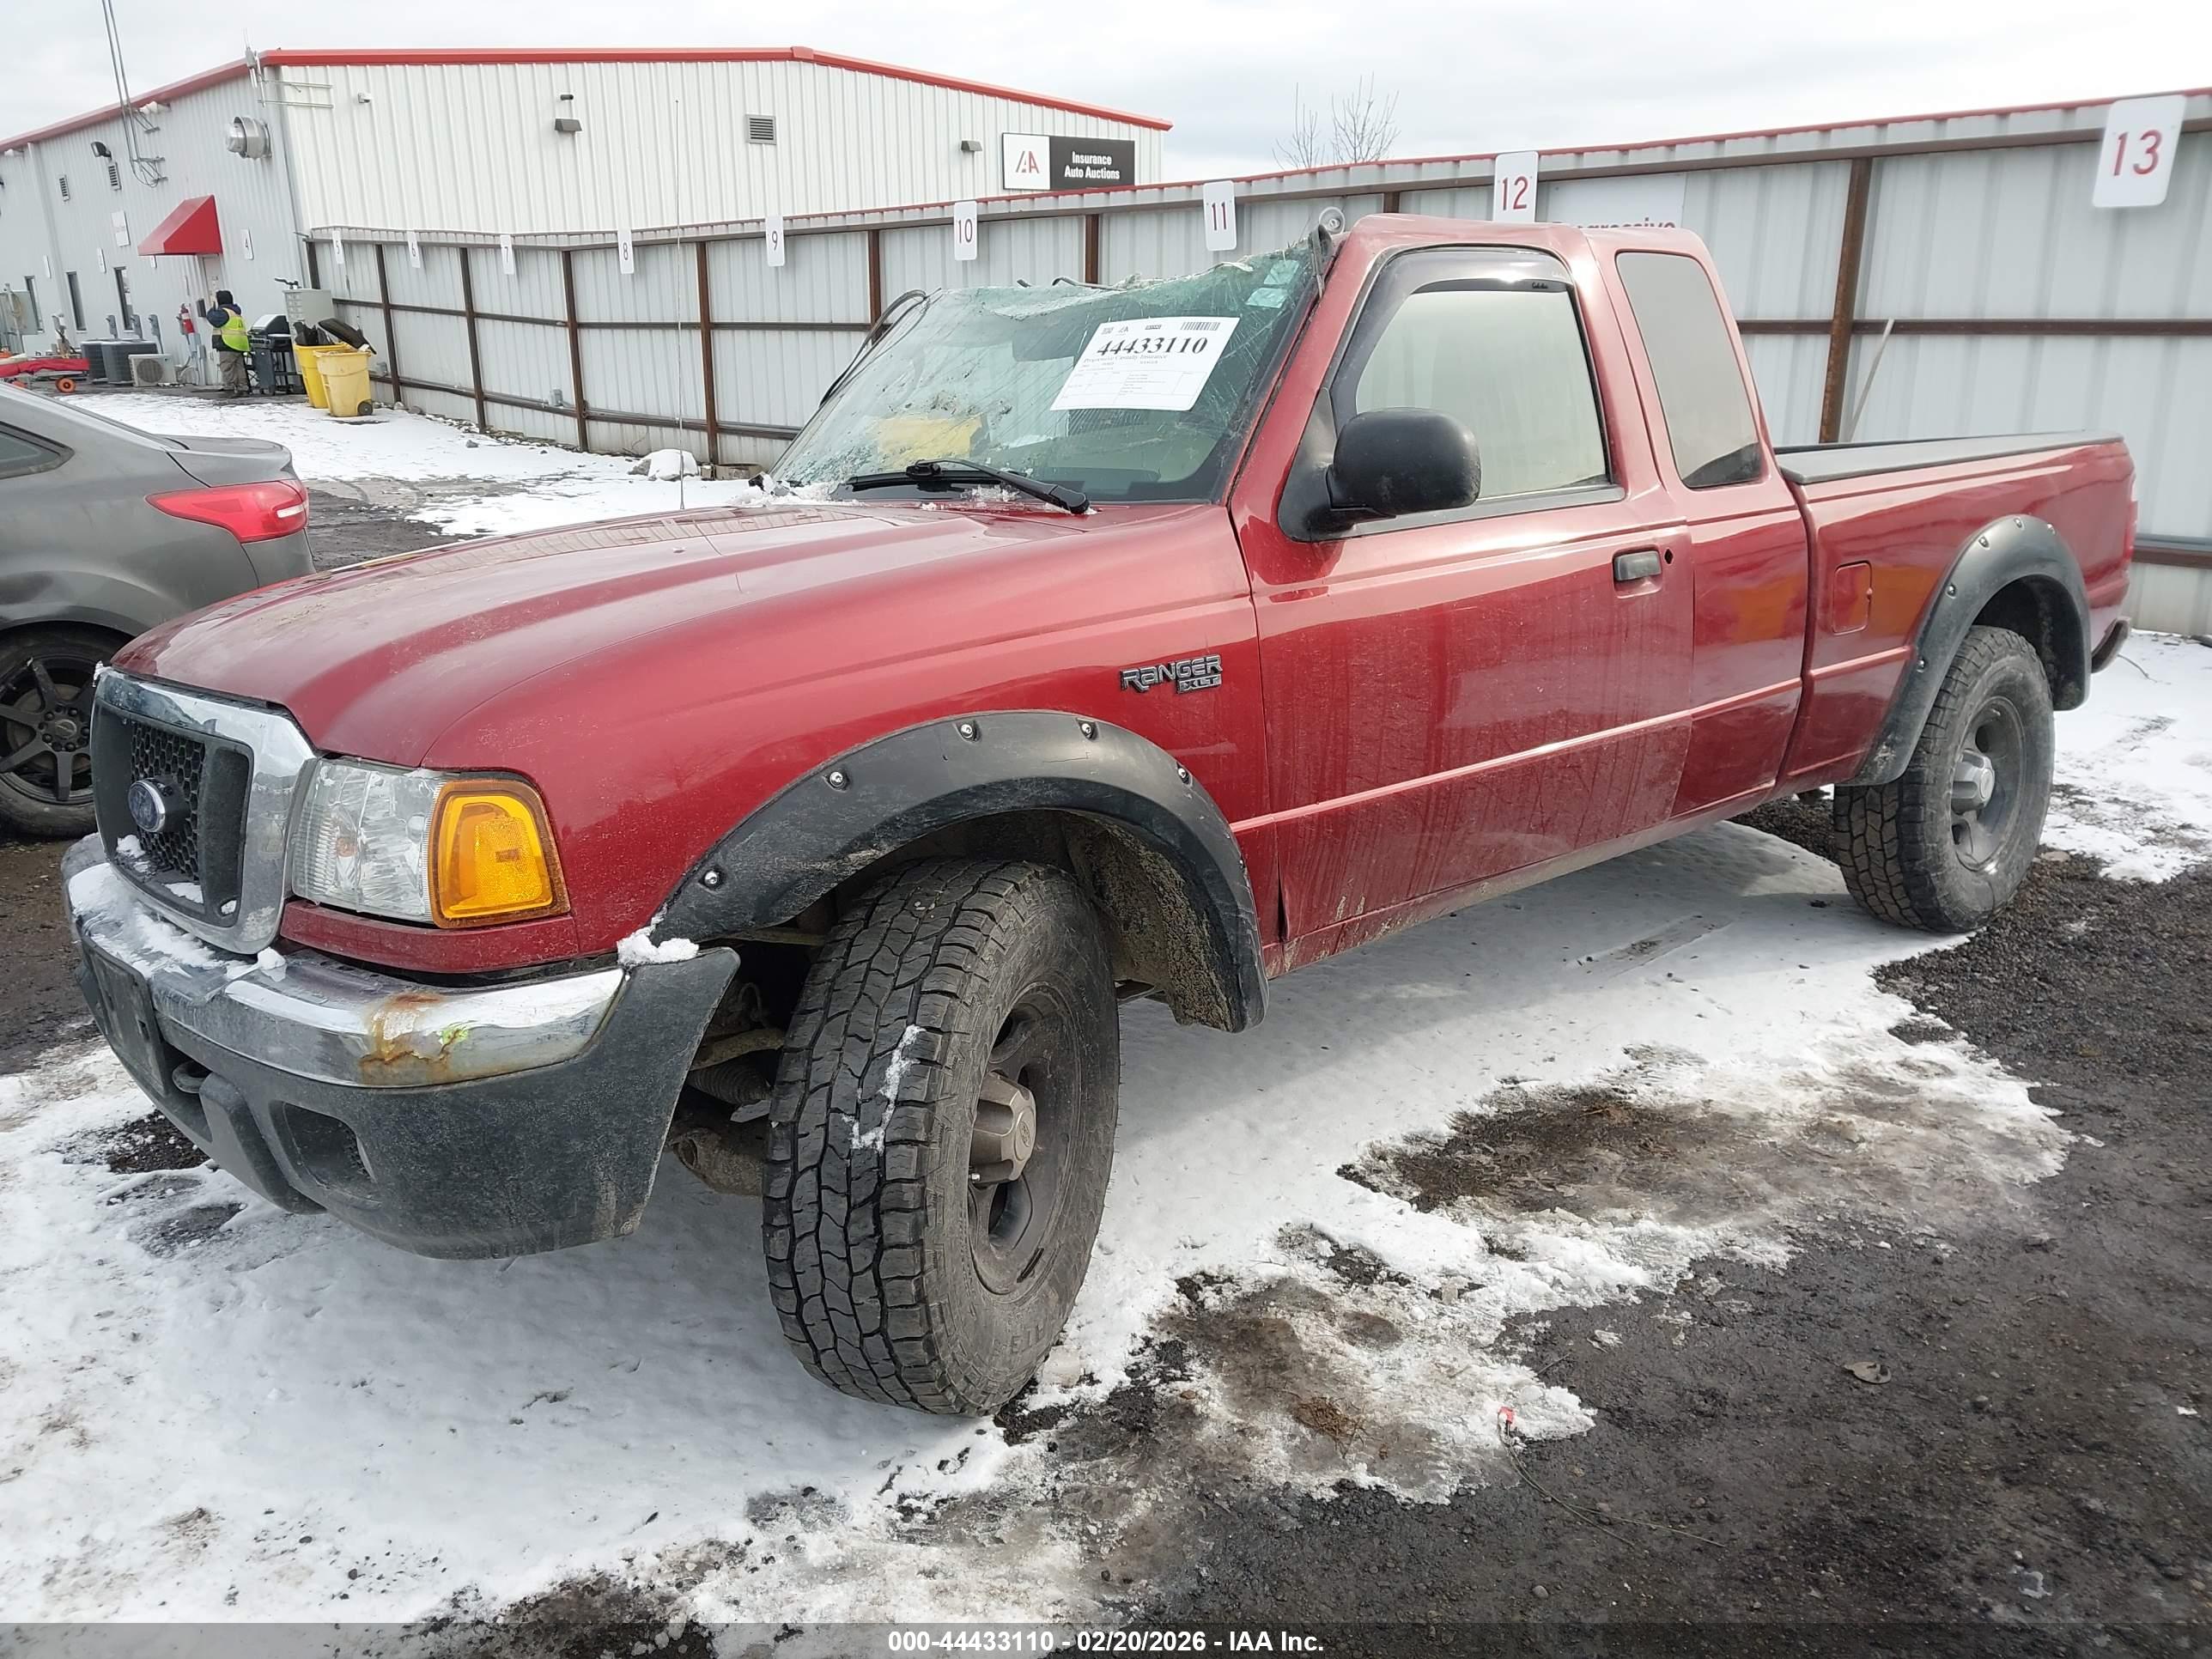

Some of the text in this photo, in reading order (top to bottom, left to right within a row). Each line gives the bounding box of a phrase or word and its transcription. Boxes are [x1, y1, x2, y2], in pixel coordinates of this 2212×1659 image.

[1073, 151, 1112, 165] Insurance
[2113, 130, 2162, 176] 13
[1064, 166, 1121, 179] Auto Auctions
[1502, 176, 1528, 210] 12
[1211, 203, 1228, 231] 11
[771, 230, 779, 251] 9
[957, 218, 973, 245] 10
[335, 240, 341, 255] 5
[411, 242, 417, 258] 6
[502, 246, 509, 264] 7
[623, 242, 629, 260] 8
[1097, 337, 1208, 356] 44433110
[1120, 653, 1223, 692] RANGER
[1180, 674, 1222, 693] XLT
